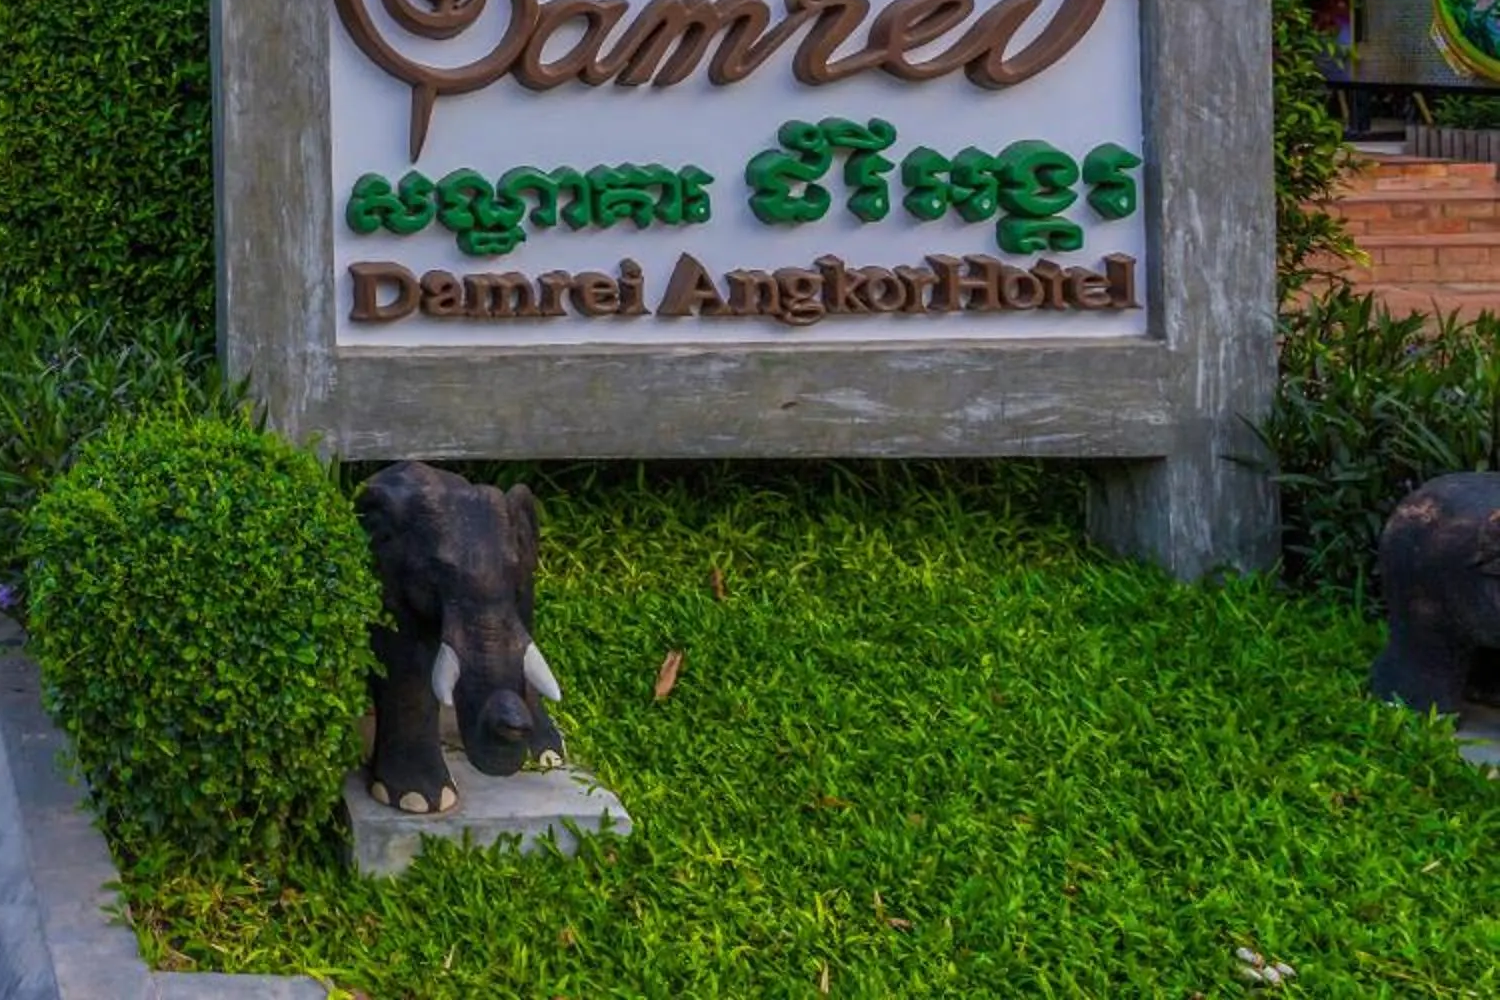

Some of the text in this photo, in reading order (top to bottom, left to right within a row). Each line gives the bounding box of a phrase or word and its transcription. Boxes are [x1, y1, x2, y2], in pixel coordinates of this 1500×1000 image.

[348, 252, 1143, 327] Damrei Angkor Hotel
